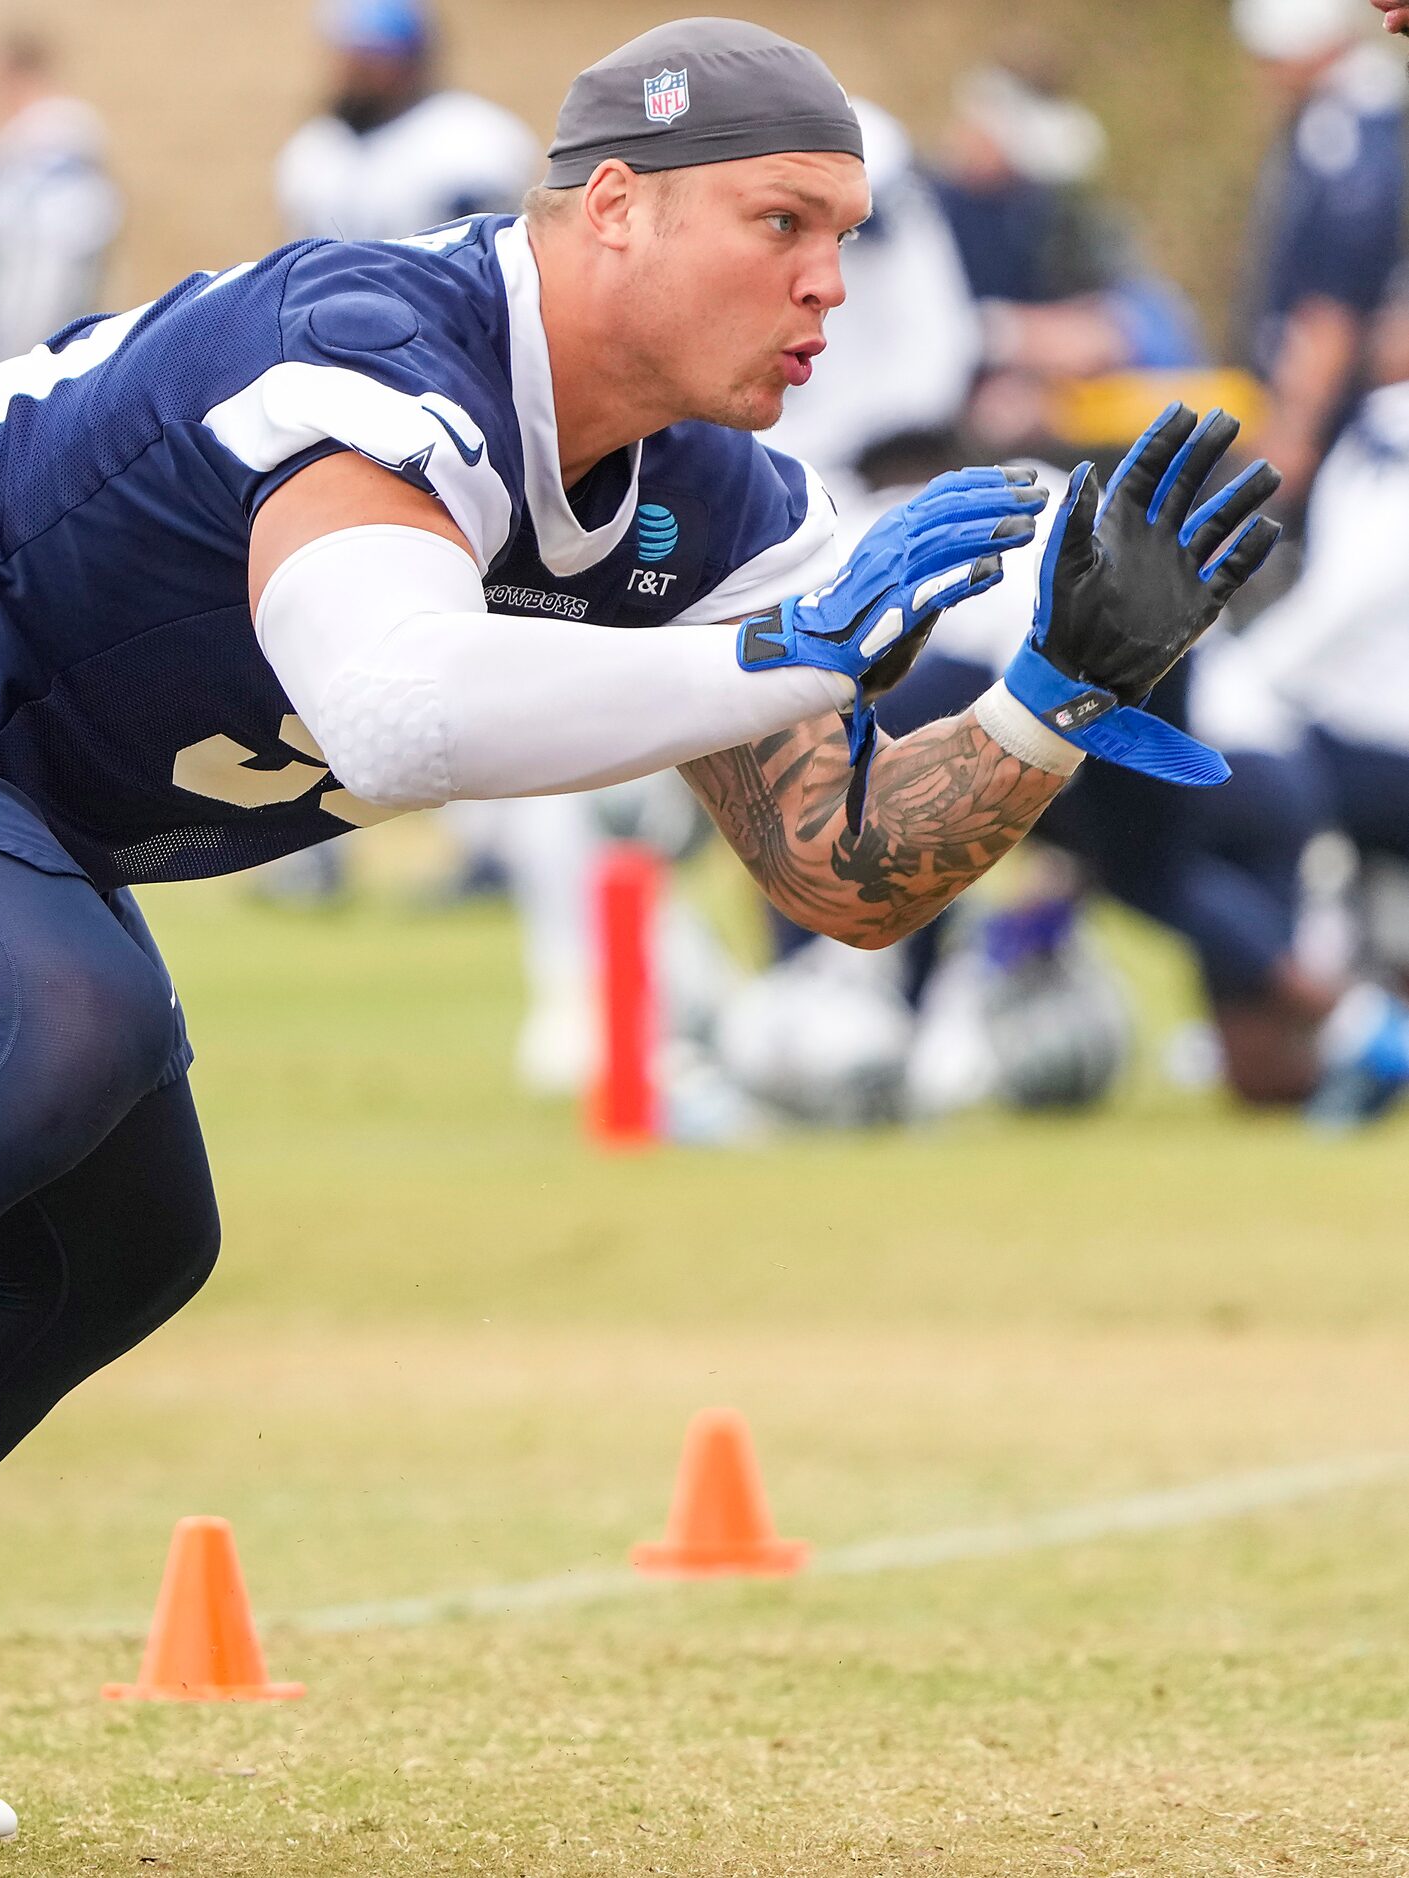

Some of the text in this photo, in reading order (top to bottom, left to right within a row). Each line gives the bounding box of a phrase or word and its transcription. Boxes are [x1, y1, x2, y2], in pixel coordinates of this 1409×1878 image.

[651, 89, 685, 115] NFL
[484, 584, 589, 619] COWBOYS
[1076, 699, 1099, 716] 2XL
